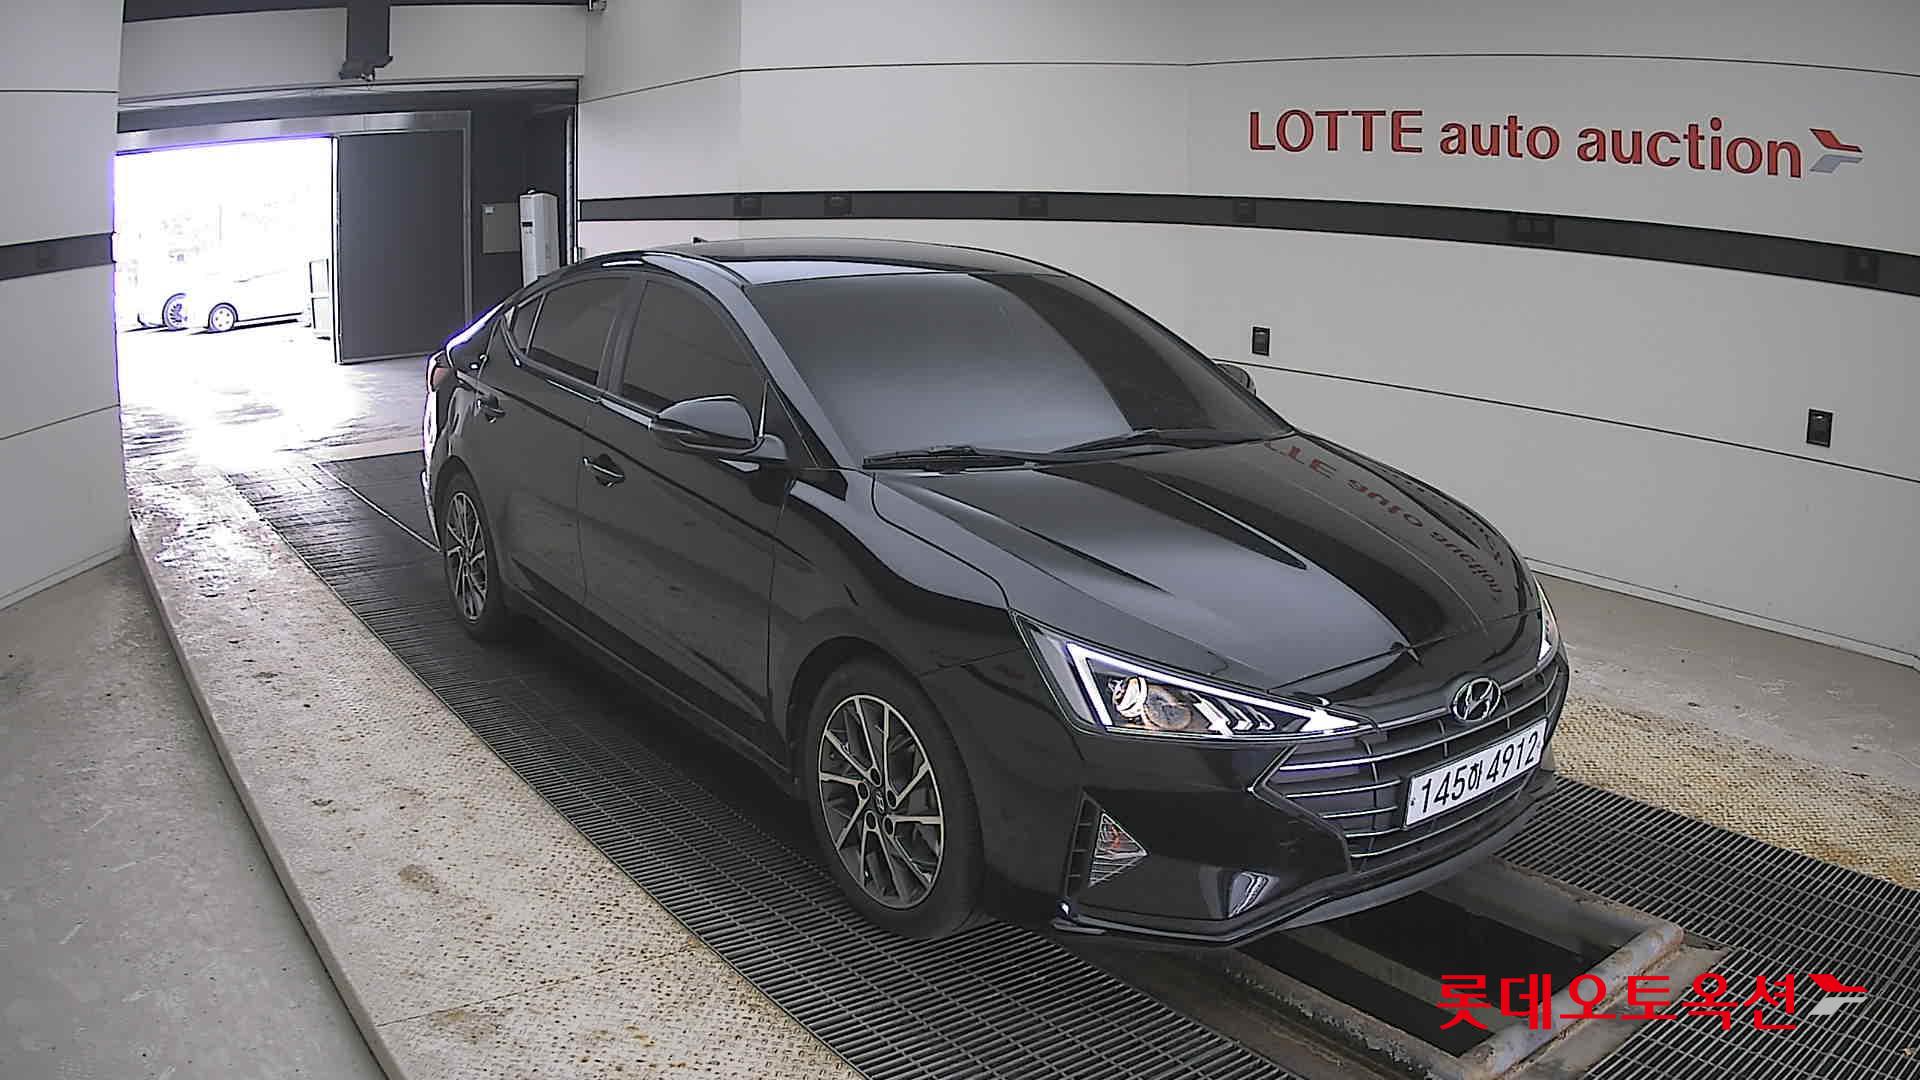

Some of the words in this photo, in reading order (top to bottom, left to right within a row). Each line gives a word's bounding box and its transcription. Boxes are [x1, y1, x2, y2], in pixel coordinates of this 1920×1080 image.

[1249, 109, 1424, 153] LOTTE
[1440, 116, 1560, 158] auto
[1577, 118, 1803, 177] auction
[1486, 731, 1538, 783] 4912
